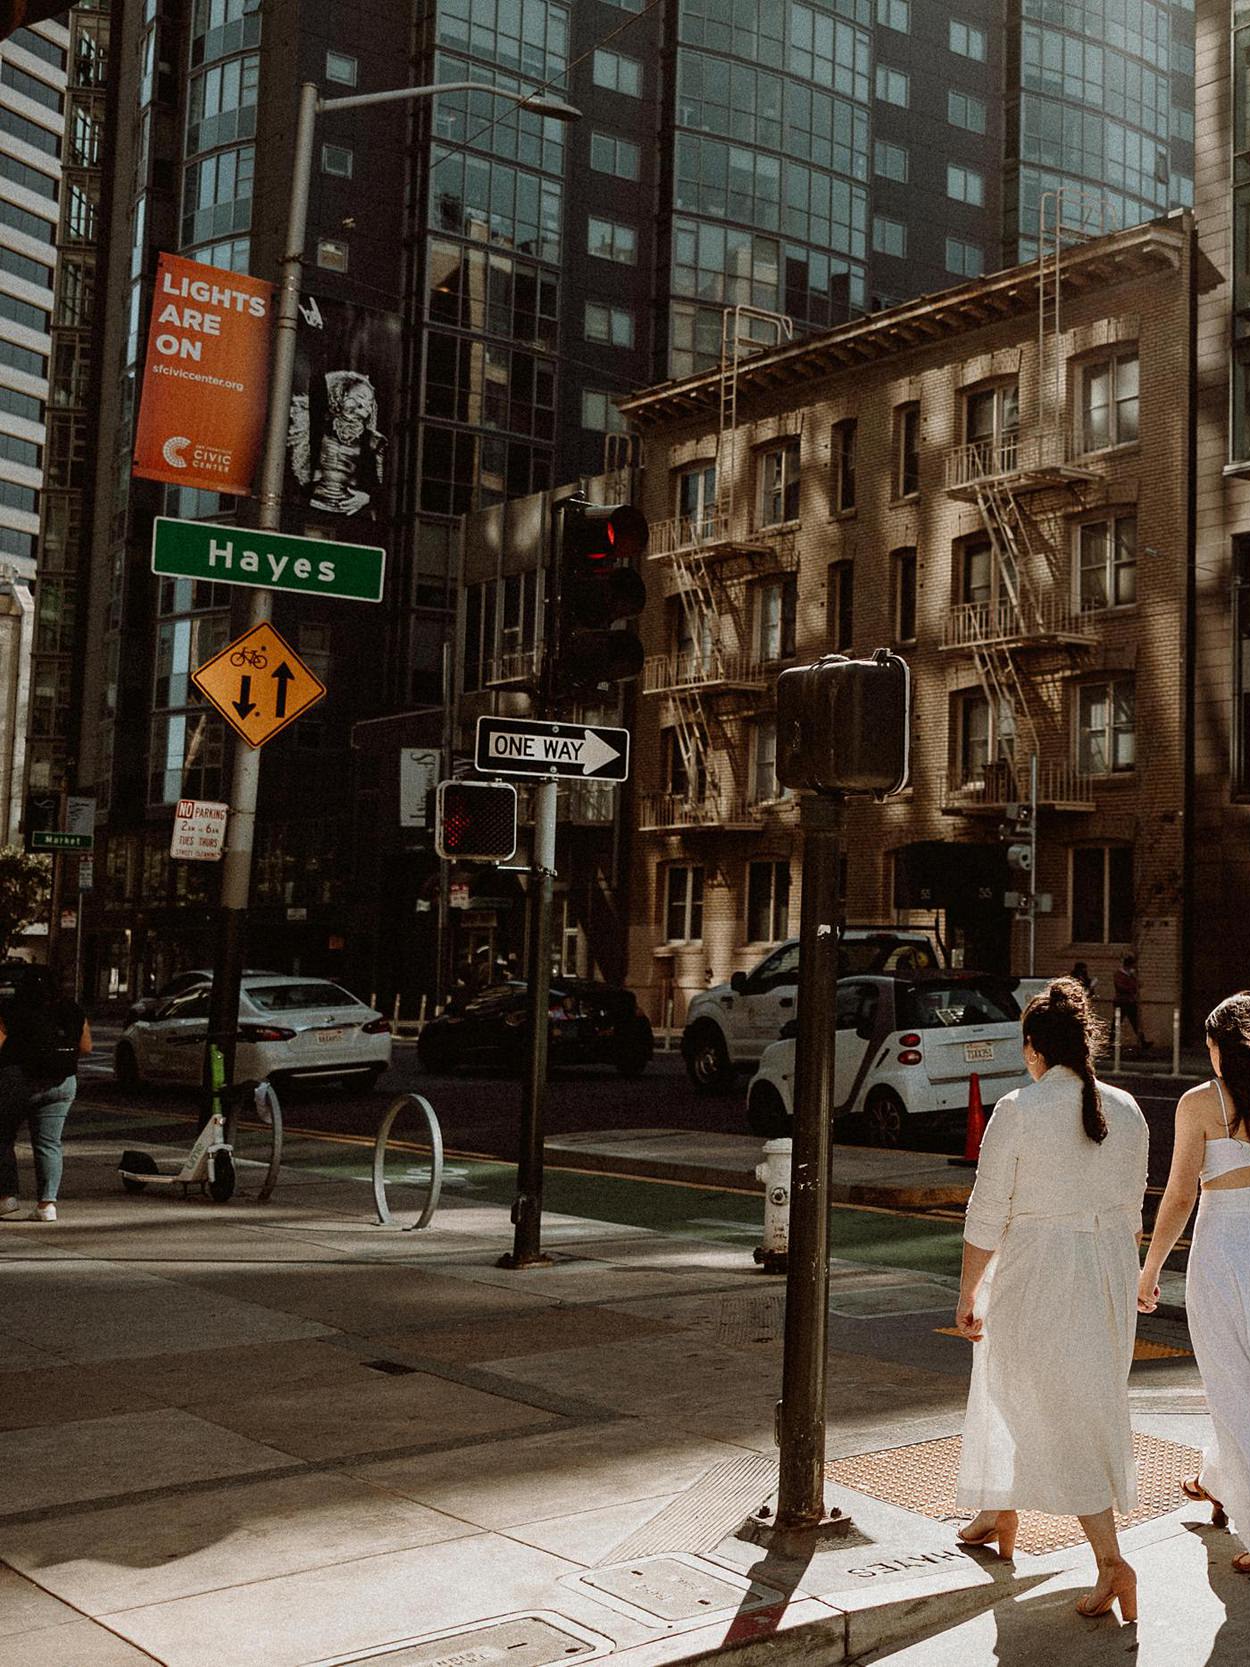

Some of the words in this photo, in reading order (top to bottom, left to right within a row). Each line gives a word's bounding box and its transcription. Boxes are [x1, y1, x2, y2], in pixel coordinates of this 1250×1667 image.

[162, 272, 266, 318] LIGHTS
[158, 304, 222, 336] ARE
[155, 334, 202, 361] ON
[152, 364, 244, 392] sfciviccenter.org
[192, 459, 230, 474] CENTER
[194, 450, 232, 465] CIVIC
[208, 539, 336, 582] Hayes
[494, 735, 535, 757] ONE
[543, 739, 585, 761] WAY
[179, 802, 193, 818] NO
[194, 807, 225, 820] PARKING
[45, 835, 81, 846] Market
[848, 1550, 966, 1578] HAYES
